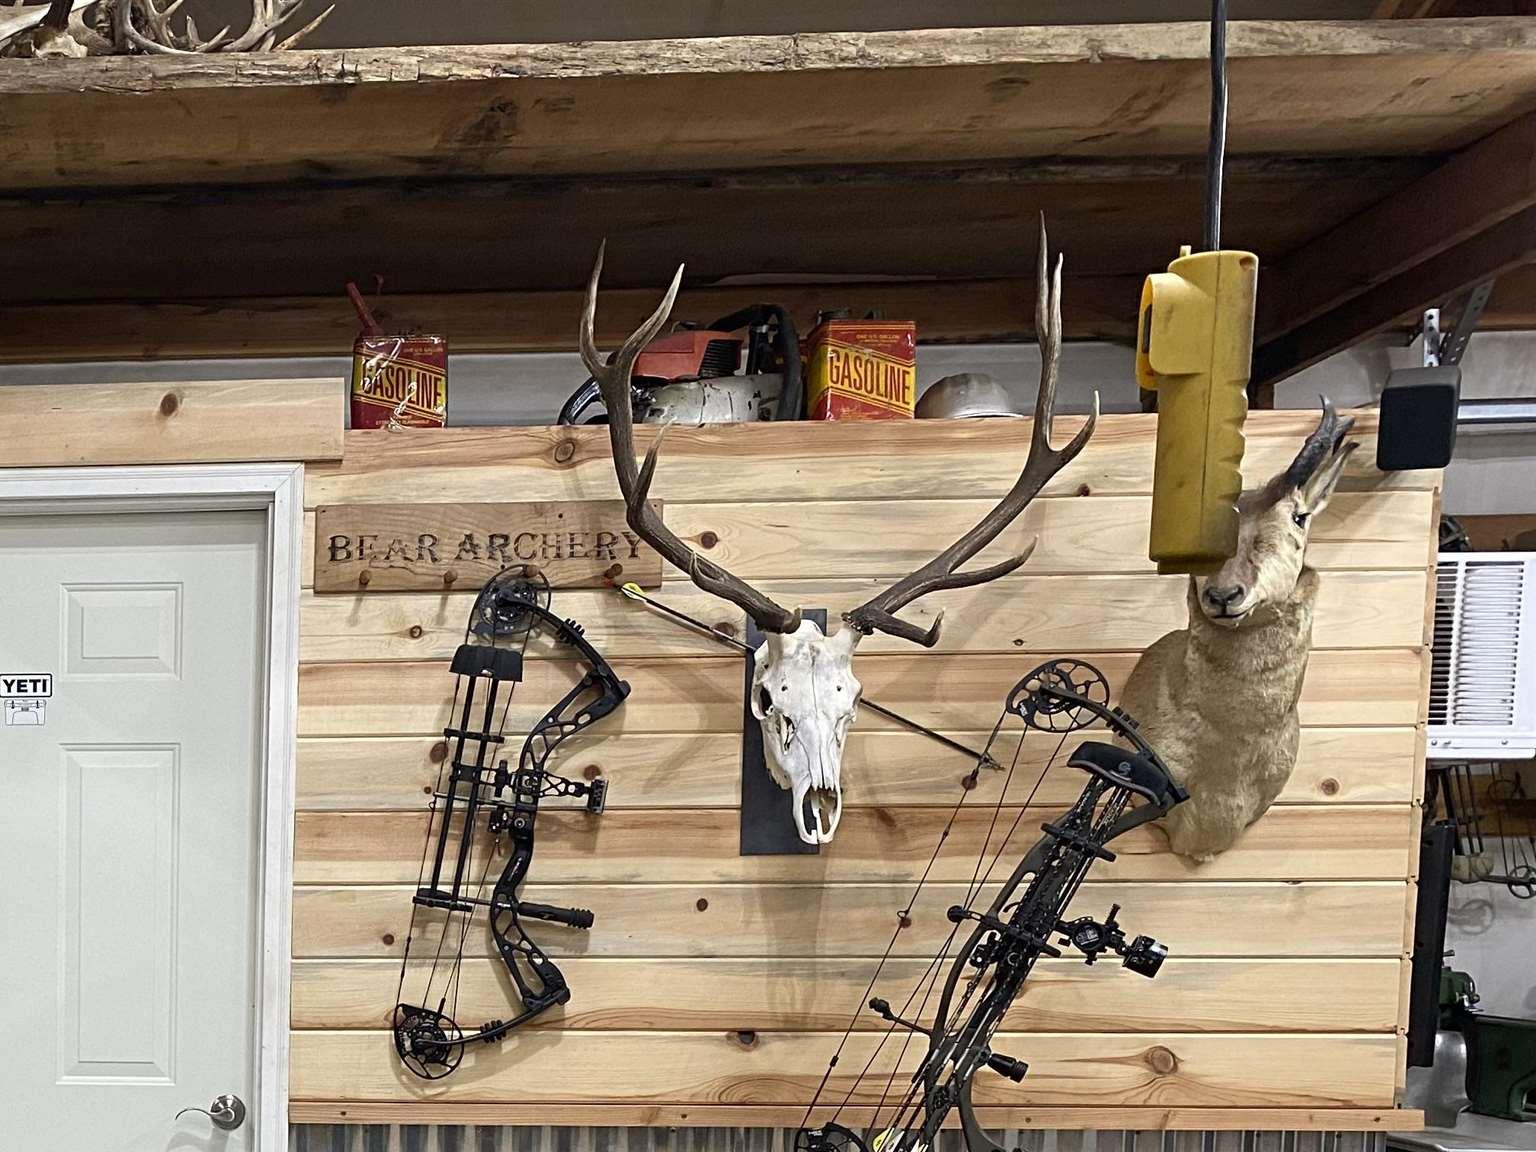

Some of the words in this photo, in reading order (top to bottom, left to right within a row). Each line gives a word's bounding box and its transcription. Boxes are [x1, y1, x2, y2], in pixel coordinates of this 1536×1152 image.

[362, 358, 443, 410] GASOLINE
[829, 349, 912, 406] GASOLINE
[327, 533, 442, 563] BEAR
[454, 532, 642, 563] ARCHERY
[2, 679, 47, 693] YETI
